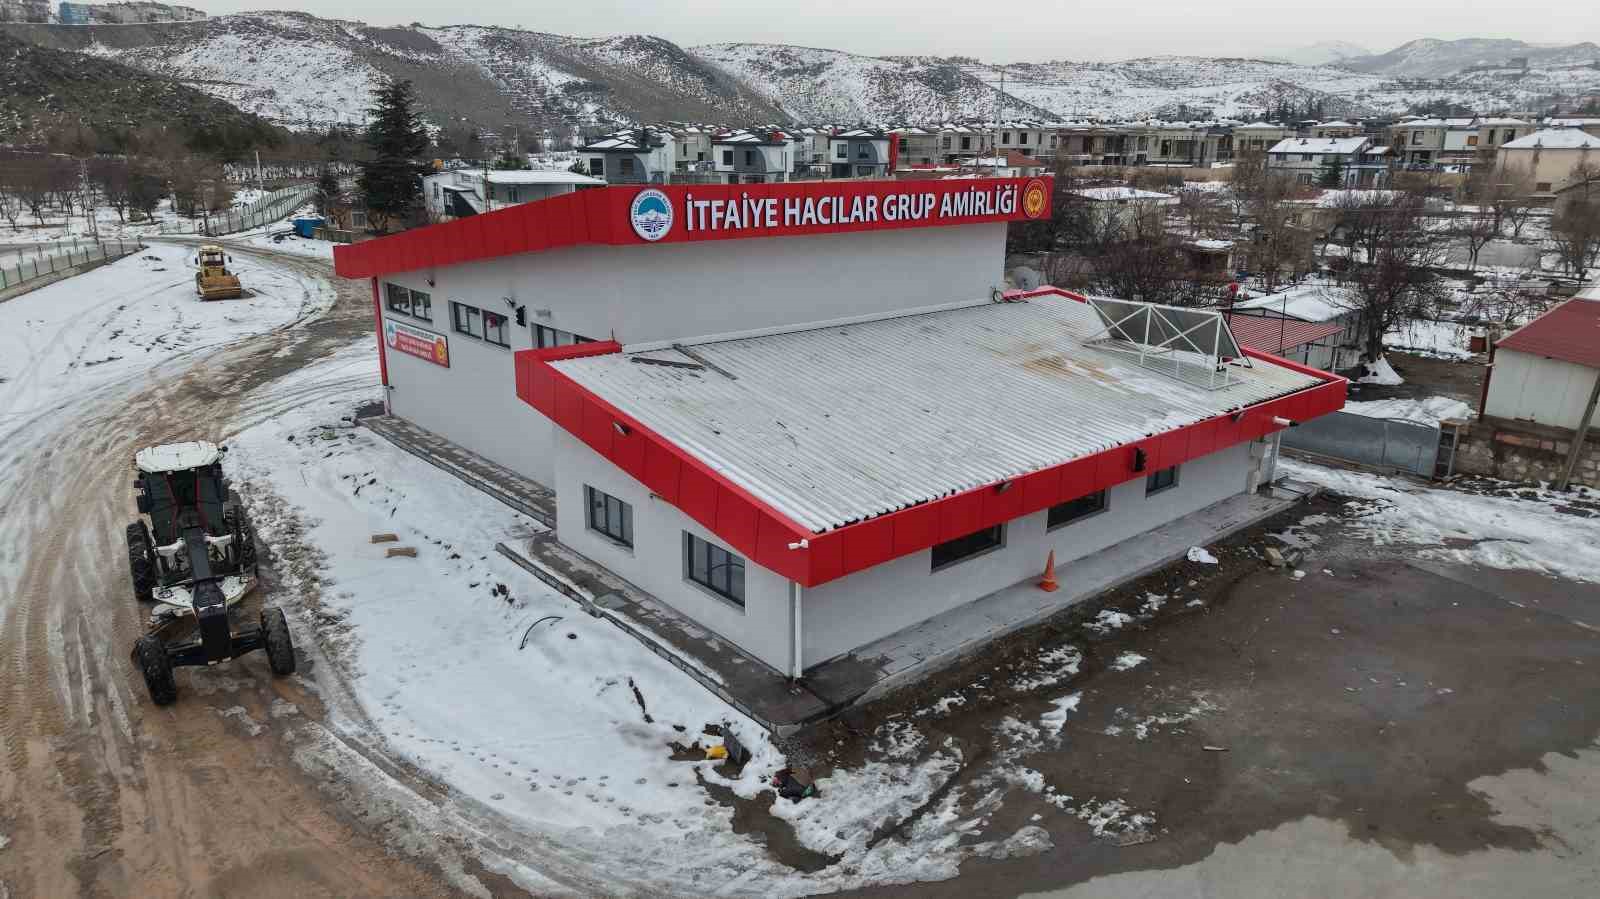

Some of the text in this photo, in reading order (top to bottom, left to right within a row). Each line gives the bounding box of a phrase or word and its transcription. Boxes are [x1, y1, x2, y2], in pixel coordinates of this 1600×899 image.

[686, 192, 777, 230] İTFAİYE
[785, 195, 877, 225] HACILAR
[882, 193, 935, 220] GRUP
[939, 185, 1018, 217] AMİRLİĞİ
